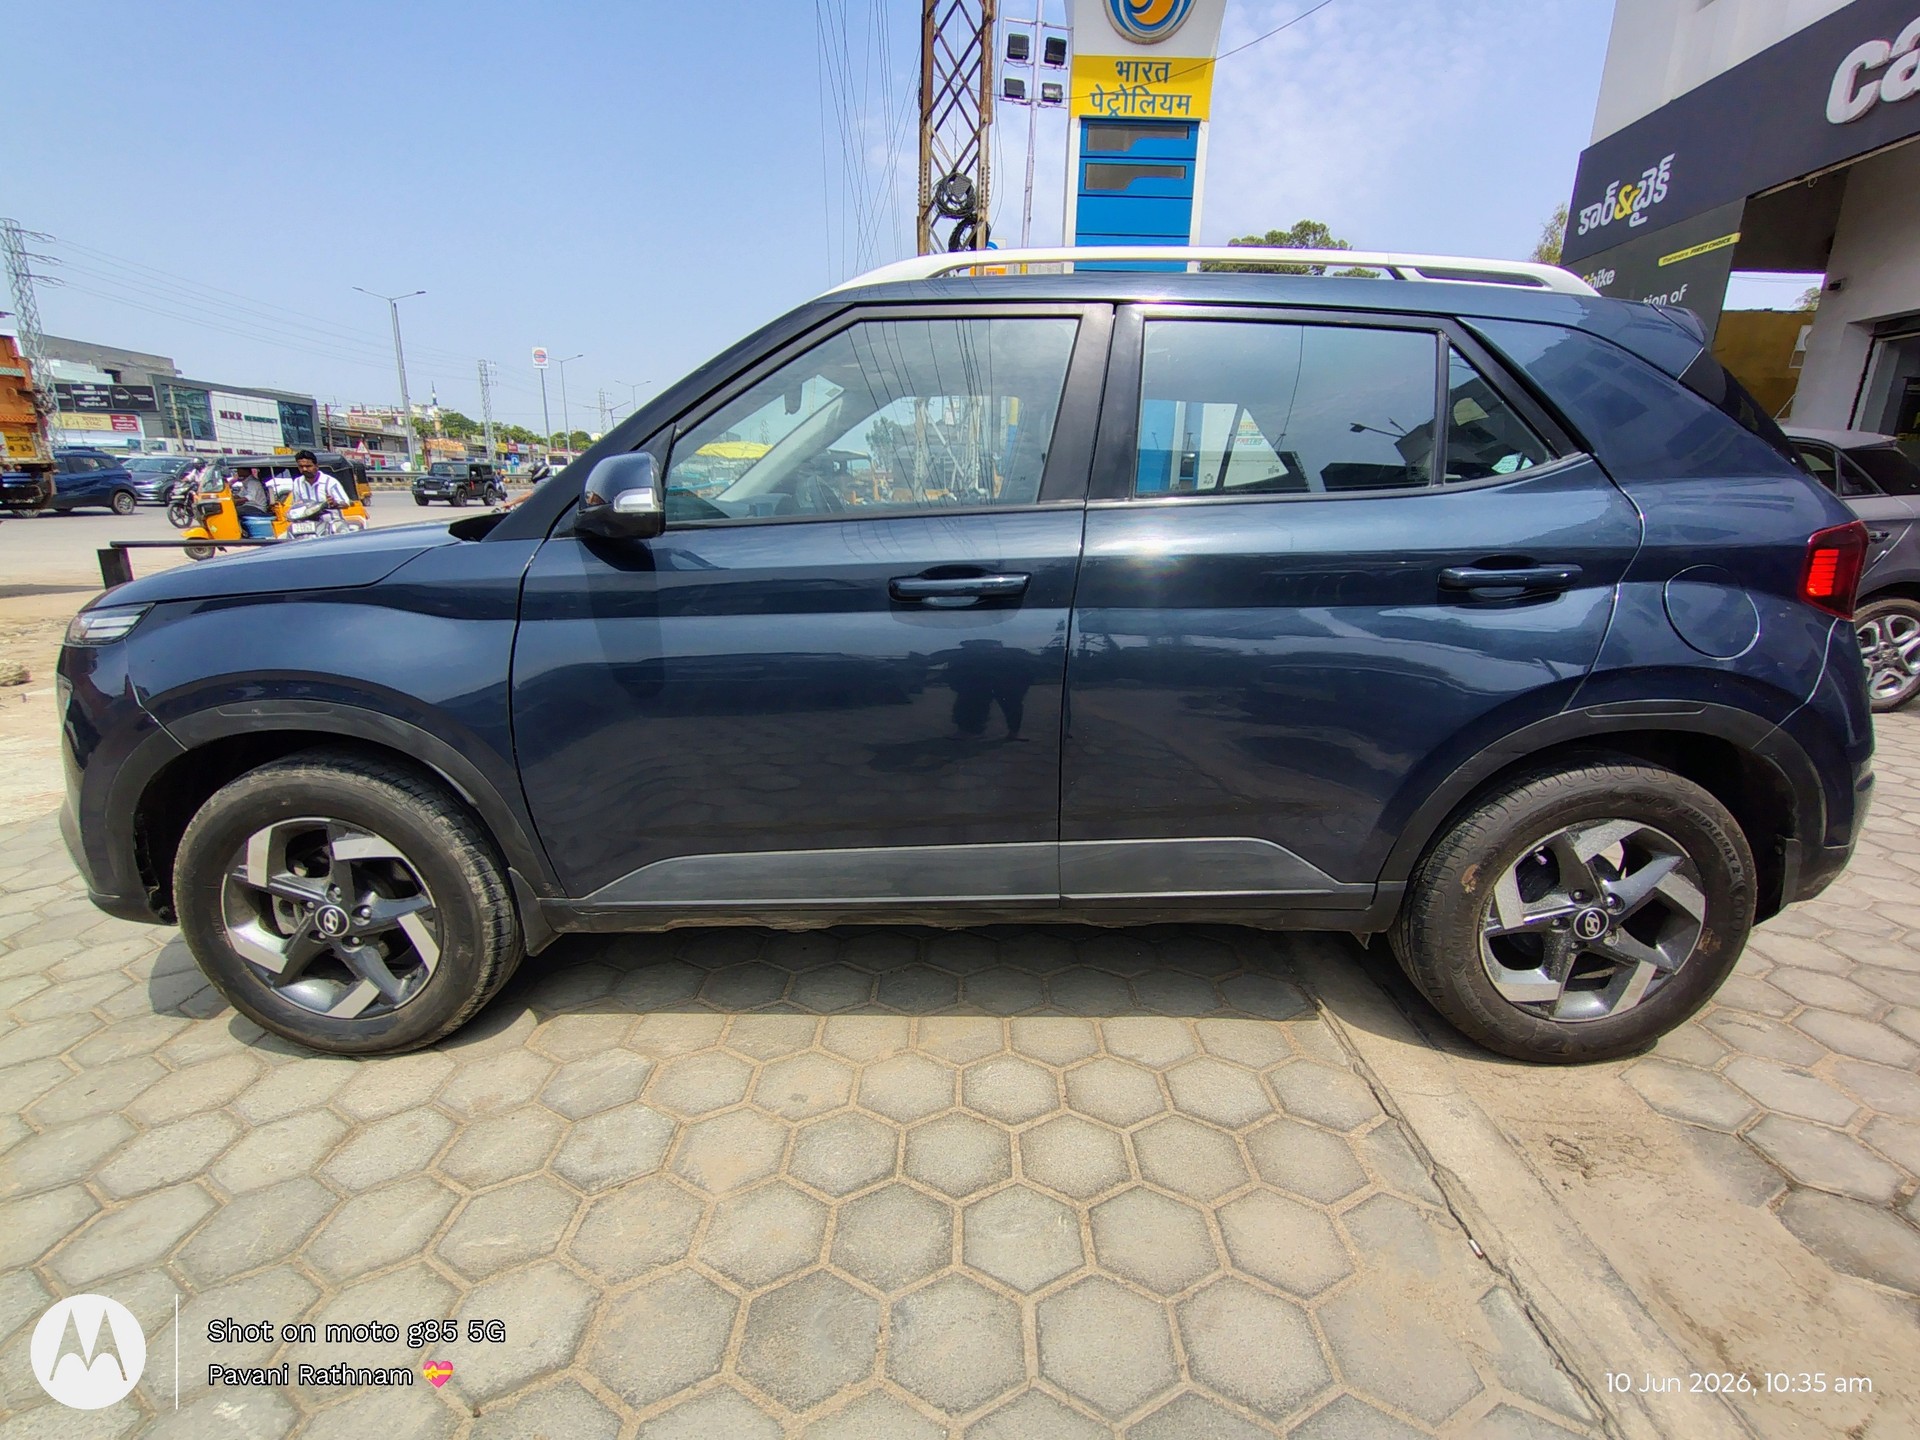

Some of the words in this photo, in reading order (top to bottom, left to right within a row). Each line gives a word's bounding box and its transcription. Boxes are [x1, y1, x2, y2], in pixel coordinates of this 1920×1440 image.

[1115, 61, 1172, 83] भारत
[1089, 83, 1192, 117] पेट्रोलियम
[1690, 243, 1709, 255] FIRST
[1708, 236, 1733, 249] CHOICE
[1670, 283, 1688, 303] of
[219, 409, 243, 421] MRR
